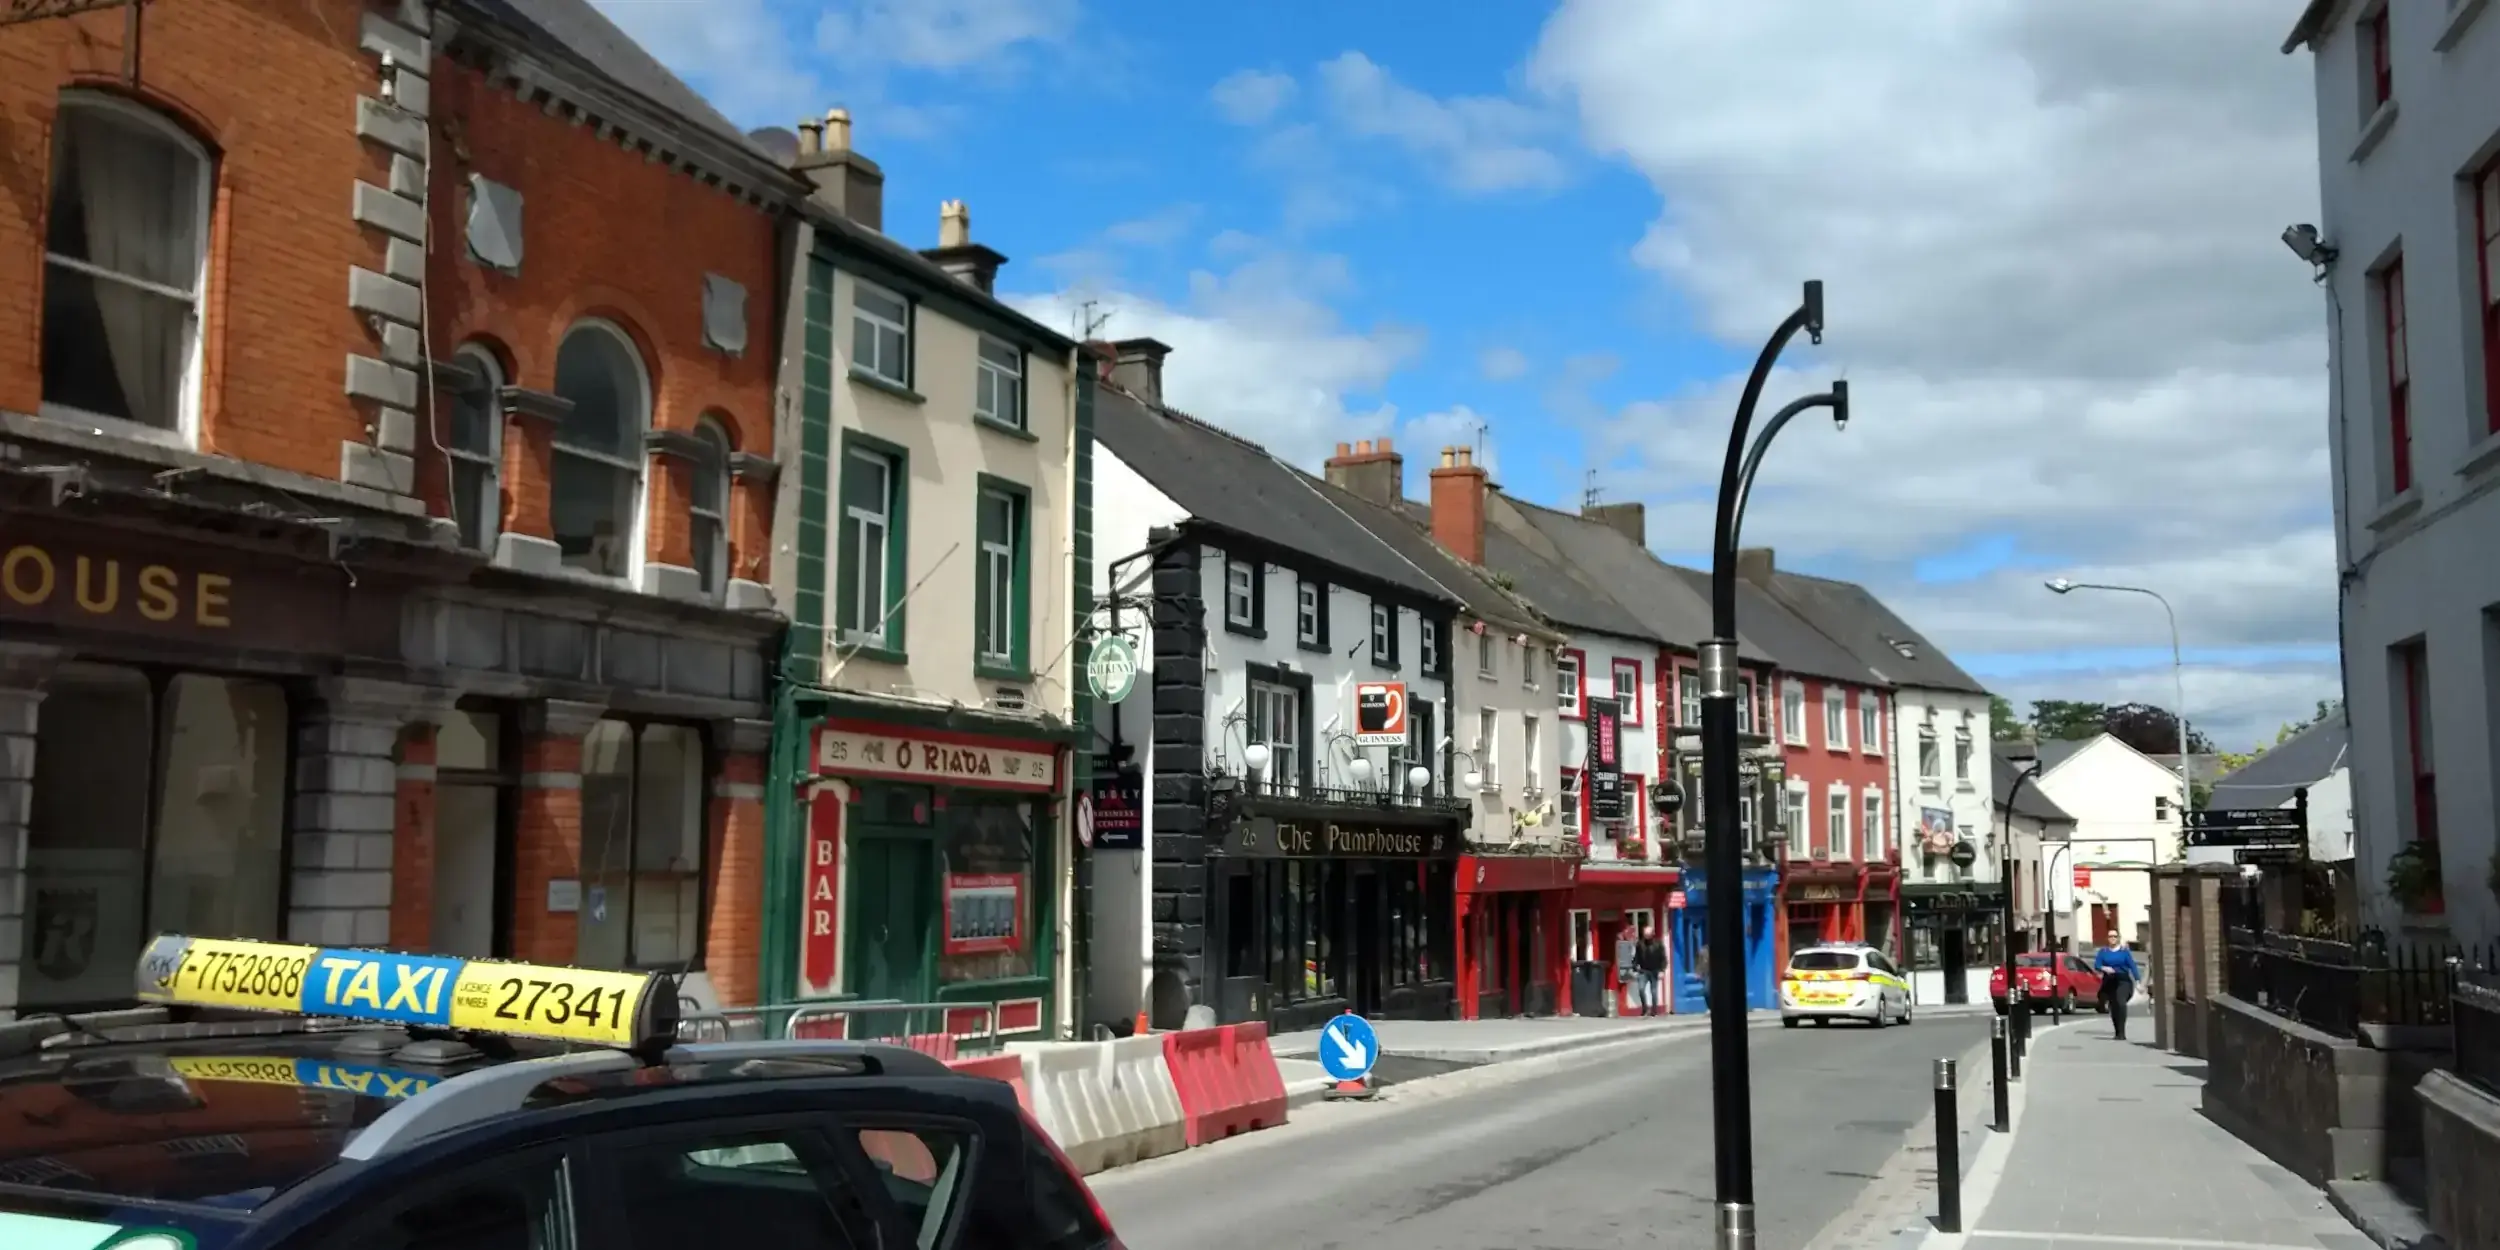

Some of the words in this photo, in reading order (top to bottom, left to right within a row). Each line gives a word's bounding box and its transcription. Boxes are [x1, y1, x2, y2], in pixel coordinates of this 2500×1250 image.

[2, 544, 232, 628] OUSE
[831, 741, 848, 760] 25
[1031, 761, 1044, 778] 25
[1359, 735, 1402, 743] GUINNESS
[1276, 823, 1313, 851] The
[1328, 824, 1422, 856] Pumphouse
[812, 839, 834, 936] BAR
[321, 957, 449, 1015] TAXI
[494, 976, 627, 1030] 27341
